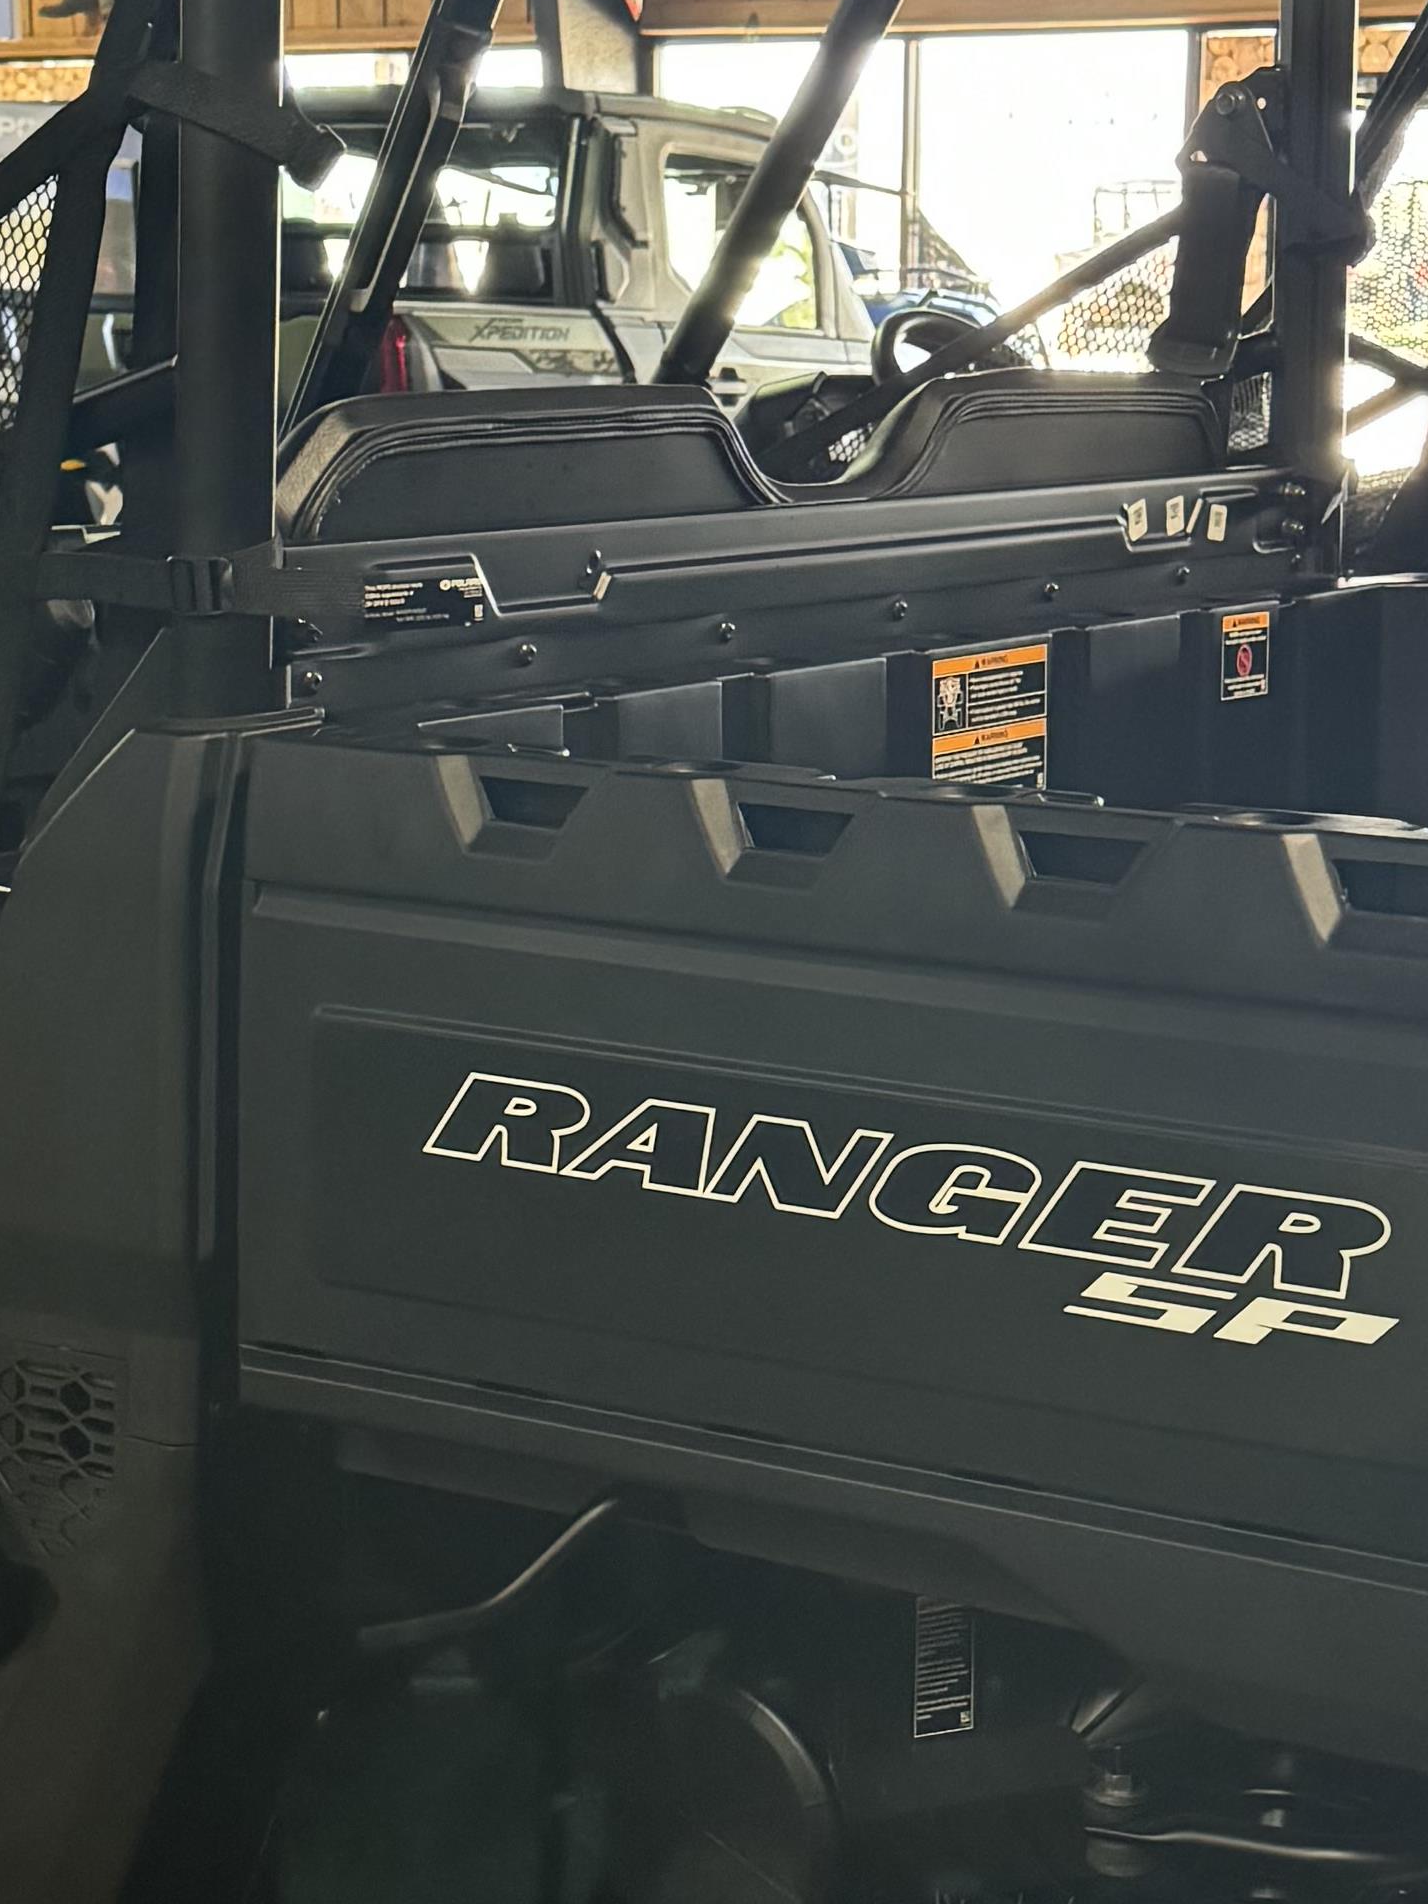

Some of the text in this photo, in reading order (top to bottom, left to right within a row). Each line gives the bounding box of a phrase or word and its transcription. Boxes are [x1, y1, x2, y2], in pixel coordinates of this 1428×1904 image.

[469, 317, 570, 343] XPEDITION
[422, 1071, 1392, 1299] RANGER
[1062, 1270, 1400, 1345] SP
